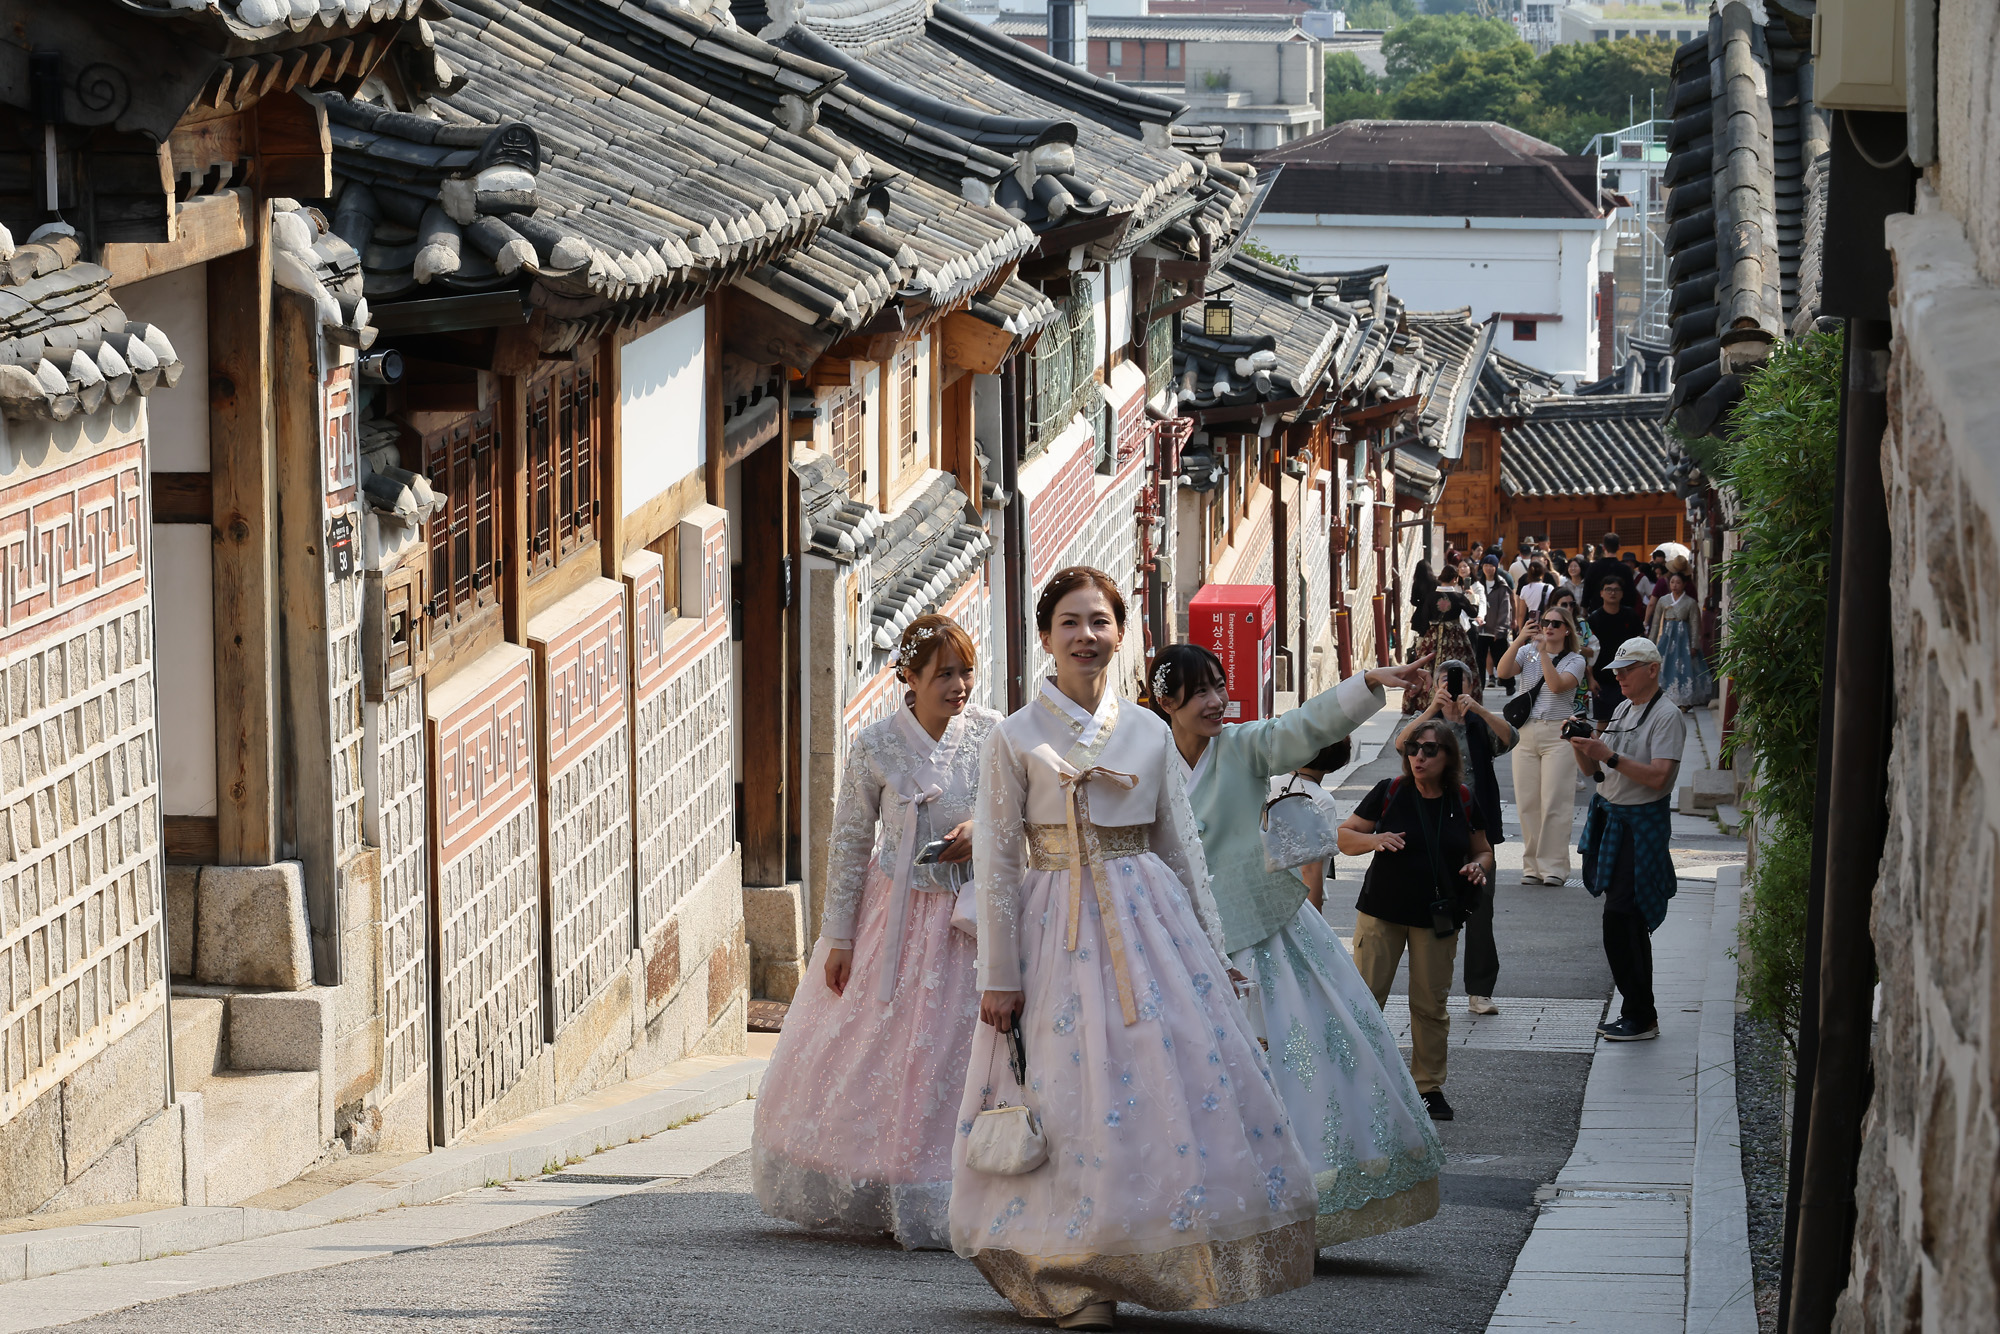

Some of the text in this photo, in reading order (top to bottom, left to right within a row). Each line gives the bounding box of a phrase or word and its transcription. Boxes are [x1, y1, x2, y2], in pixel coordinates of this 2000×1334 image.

[339, 550, 348, 572] 58
[1228, 613, 1236, 649] Emergency
[1228, 664, 1236, 691] Hydrant
